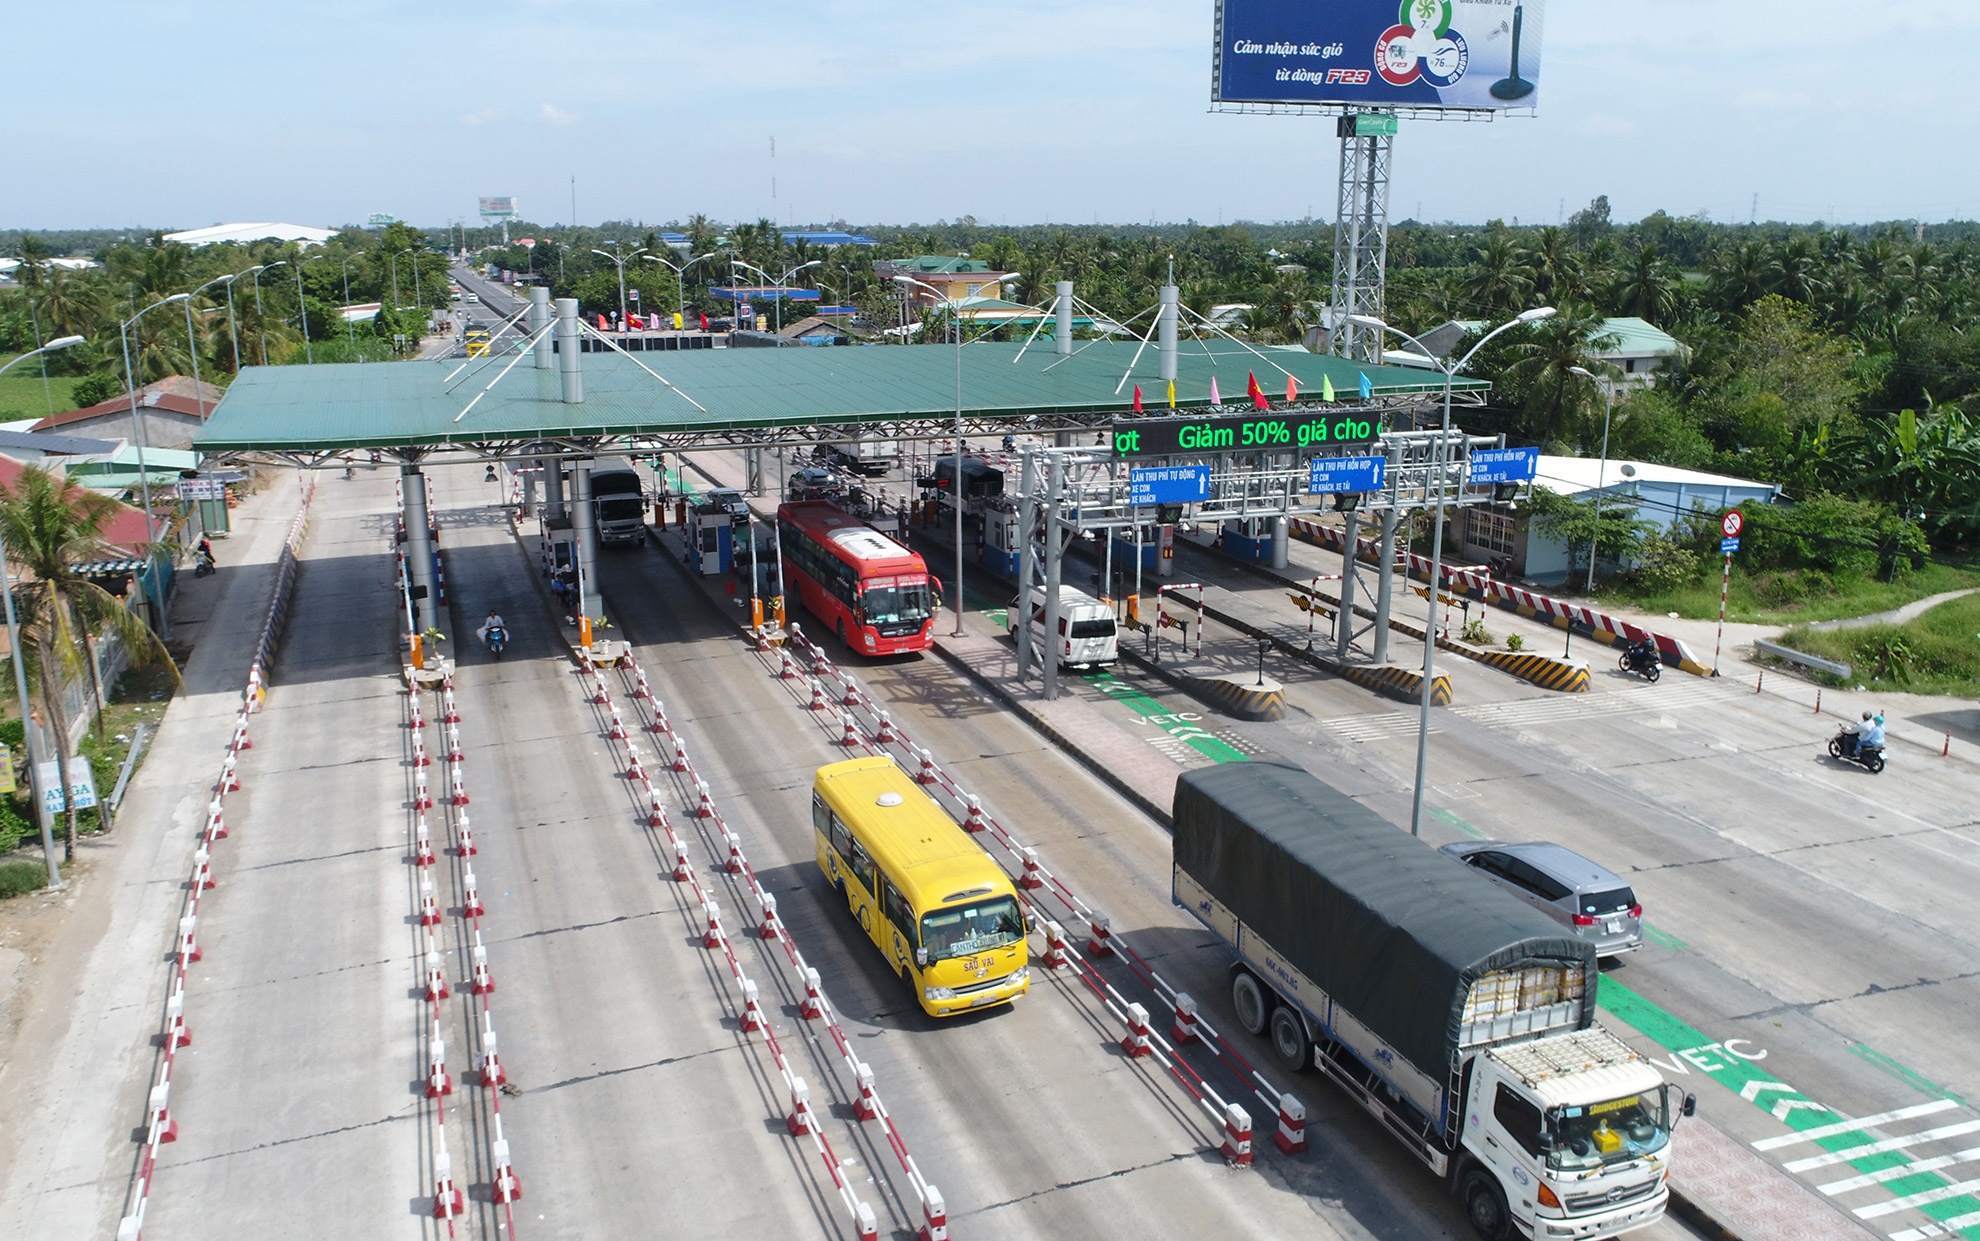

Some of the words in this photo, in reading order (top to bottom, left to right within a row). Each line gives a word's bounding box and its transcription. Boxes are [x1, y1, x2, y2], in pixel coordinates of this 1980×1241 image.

[1234, 40, 1263, 54] Cảm
[1265, 42, 1297, 57] nhận
[1300, 42, 1320, 55] sức
[1321, 42, 1343, 59] gió
[1275, 67, 1291, 81] từ
[1291, 67, 1323, 85] dòng
[1325, 69, 1371, 84] F23
[1179, 423, 1233, 448] Giảm
[1242, 421, 1290, 445] 50%
[1297, 417, 1327, 447] giá
[1334, 418, 1370, 440] cho
[1484, 453, 1494, 462] THU
[1325, 461, 1336, 471] THU
[1132, 471, 1144, 482] LÀN
[1145, 471, 1157, 481] THU
[1158, 469, 1169, 480] PHÍ
[1312, 474, 1319, 482] XE
[1132, 485, 1139, 493] XE
[1139, 484, 1150, 492] CON
[1336, 482, 1342, 490] XE
[1131, 495, 1138, 503] XE
[1128, 712, 1203, 726] VETC
[1649, 1038, 1768, 1075] VETC
